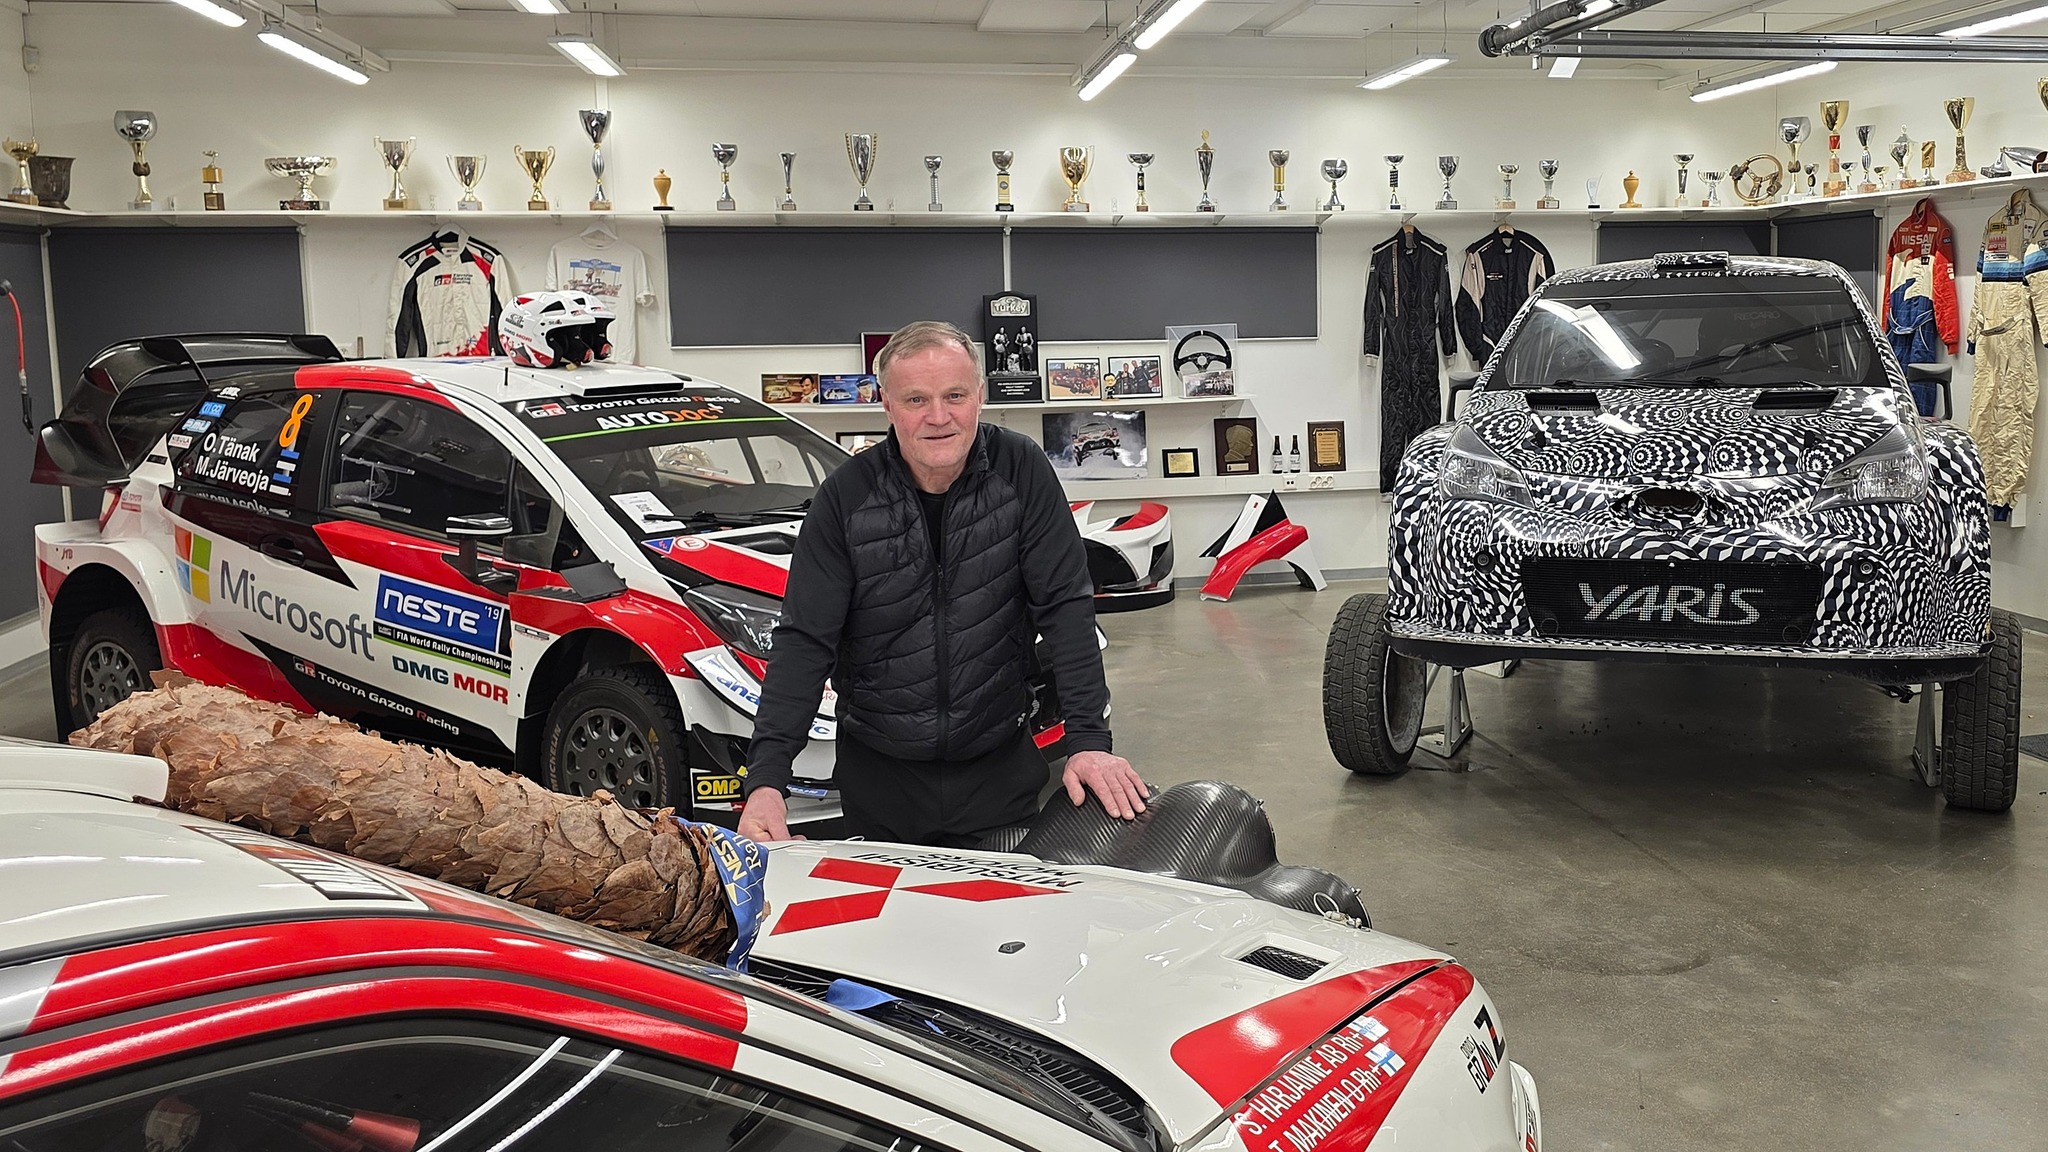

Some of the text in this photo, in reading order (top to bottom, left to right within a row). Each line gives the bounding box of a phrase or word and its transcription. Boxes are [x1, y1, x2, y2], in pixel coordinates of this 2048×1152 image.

[994, 302, 1026, 313] Turkey
[279, 394, 313, 447] 8
[566, 400, 635, 412] TOYOTA
[635, 396, 692, 405] GAZOO
[691, 395, 741, 404] Racing
[220, 560, 375, 661] Microsoft
[383, 588, 480, 635] NESTE
[396, 631, 408, 643] FIA
[410, 635, 431, 648] World
[432, 642, 450, 654] Rally
[452, 646, 500, 669] Championship
[392, 656, 508, 704] DMG MOR
[318, 671, 366, 698] TOYOTA
[369, 692, 414, 716] GAZOO
[416, 709, 460, 735] Racing
[550, 723, 562, 792] MICHELIN
[697, 780, 741, 796] OMP
[732, 833, 762, 871] Rall
[850, 853, 1084, 887] MITSUBISHI
[918, 853, 1082, 877] MOTORS
[1248, 1056, 1333, 1123] HARJANNE
[1315, 1043, 1348, 1069] AB
